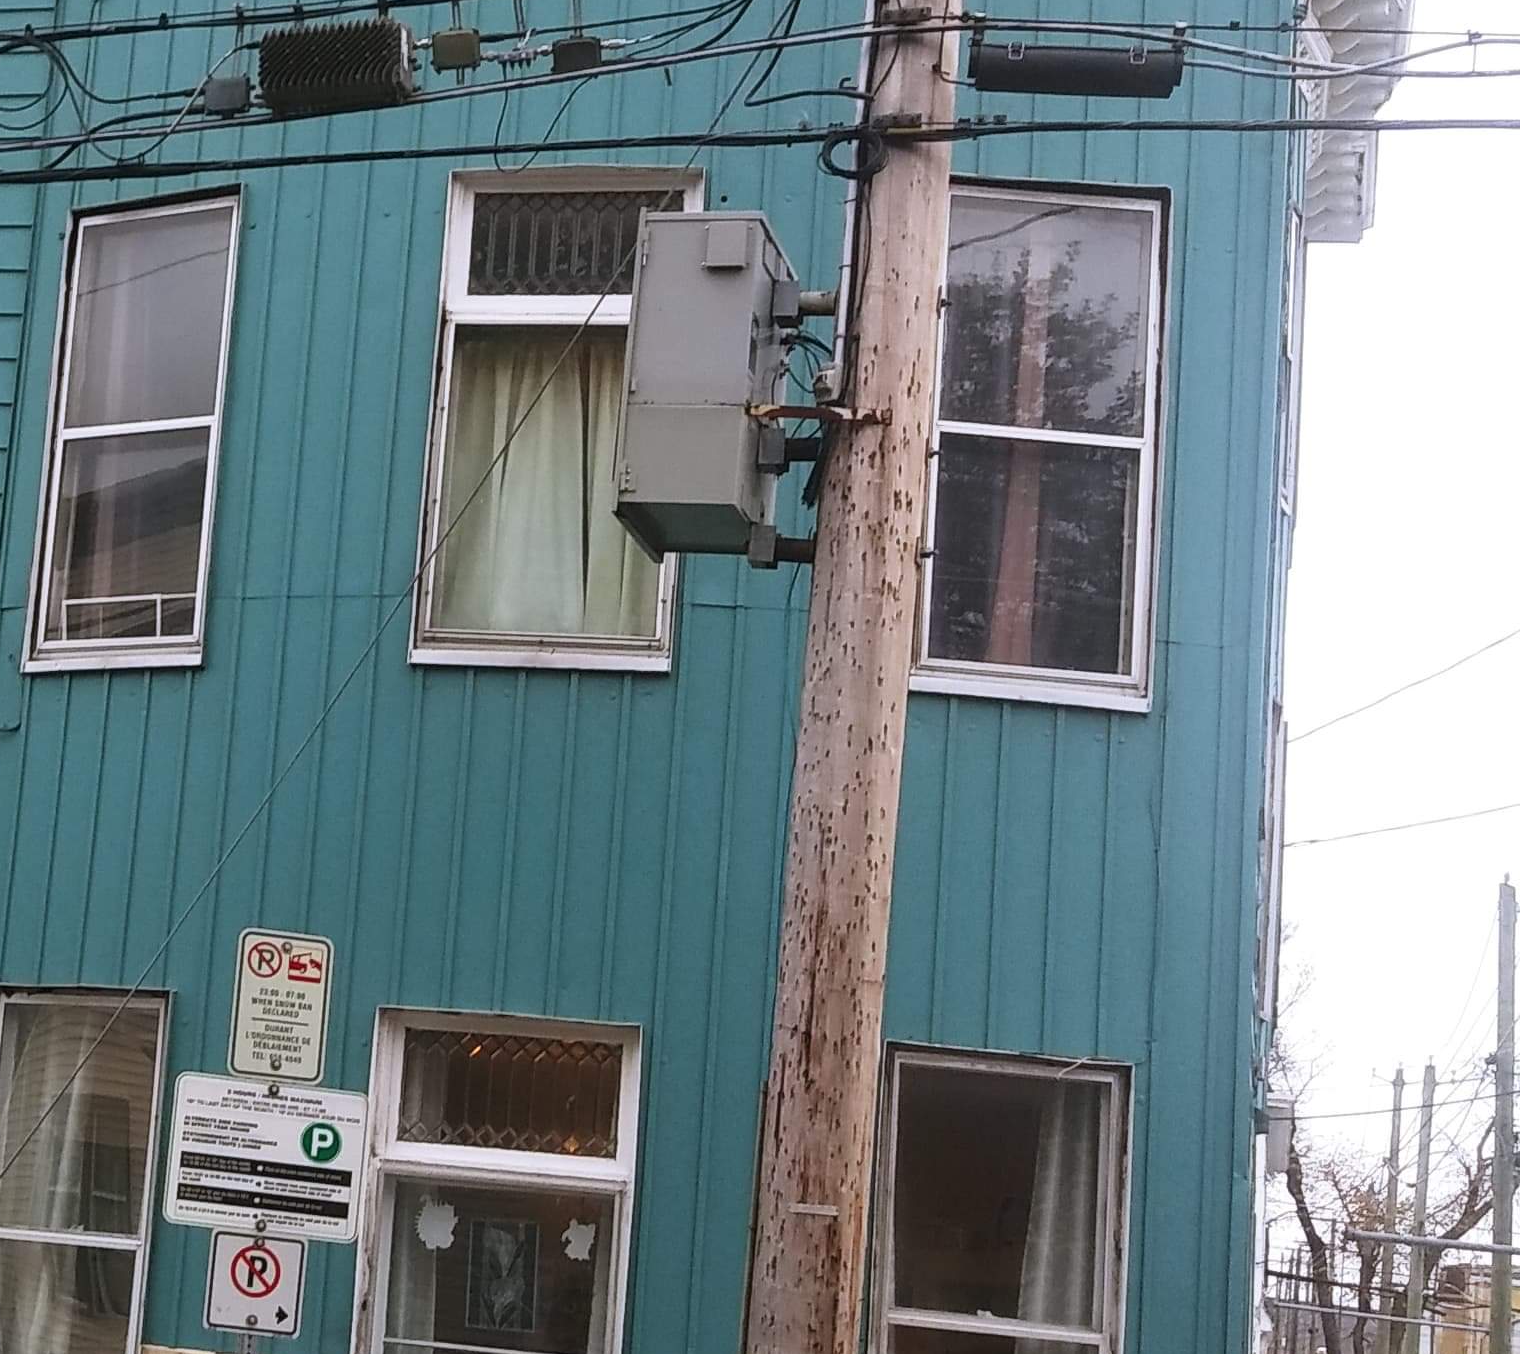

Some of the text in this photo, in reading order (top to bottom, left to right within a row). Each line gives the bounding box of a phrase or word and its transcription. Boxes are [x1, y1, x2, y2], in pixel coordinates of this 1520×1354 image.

[251, 997, 273, 1006] WHEN
[262, 1007, 300, 1018] DECLARED
[310, 1127, 334, 1157] P
